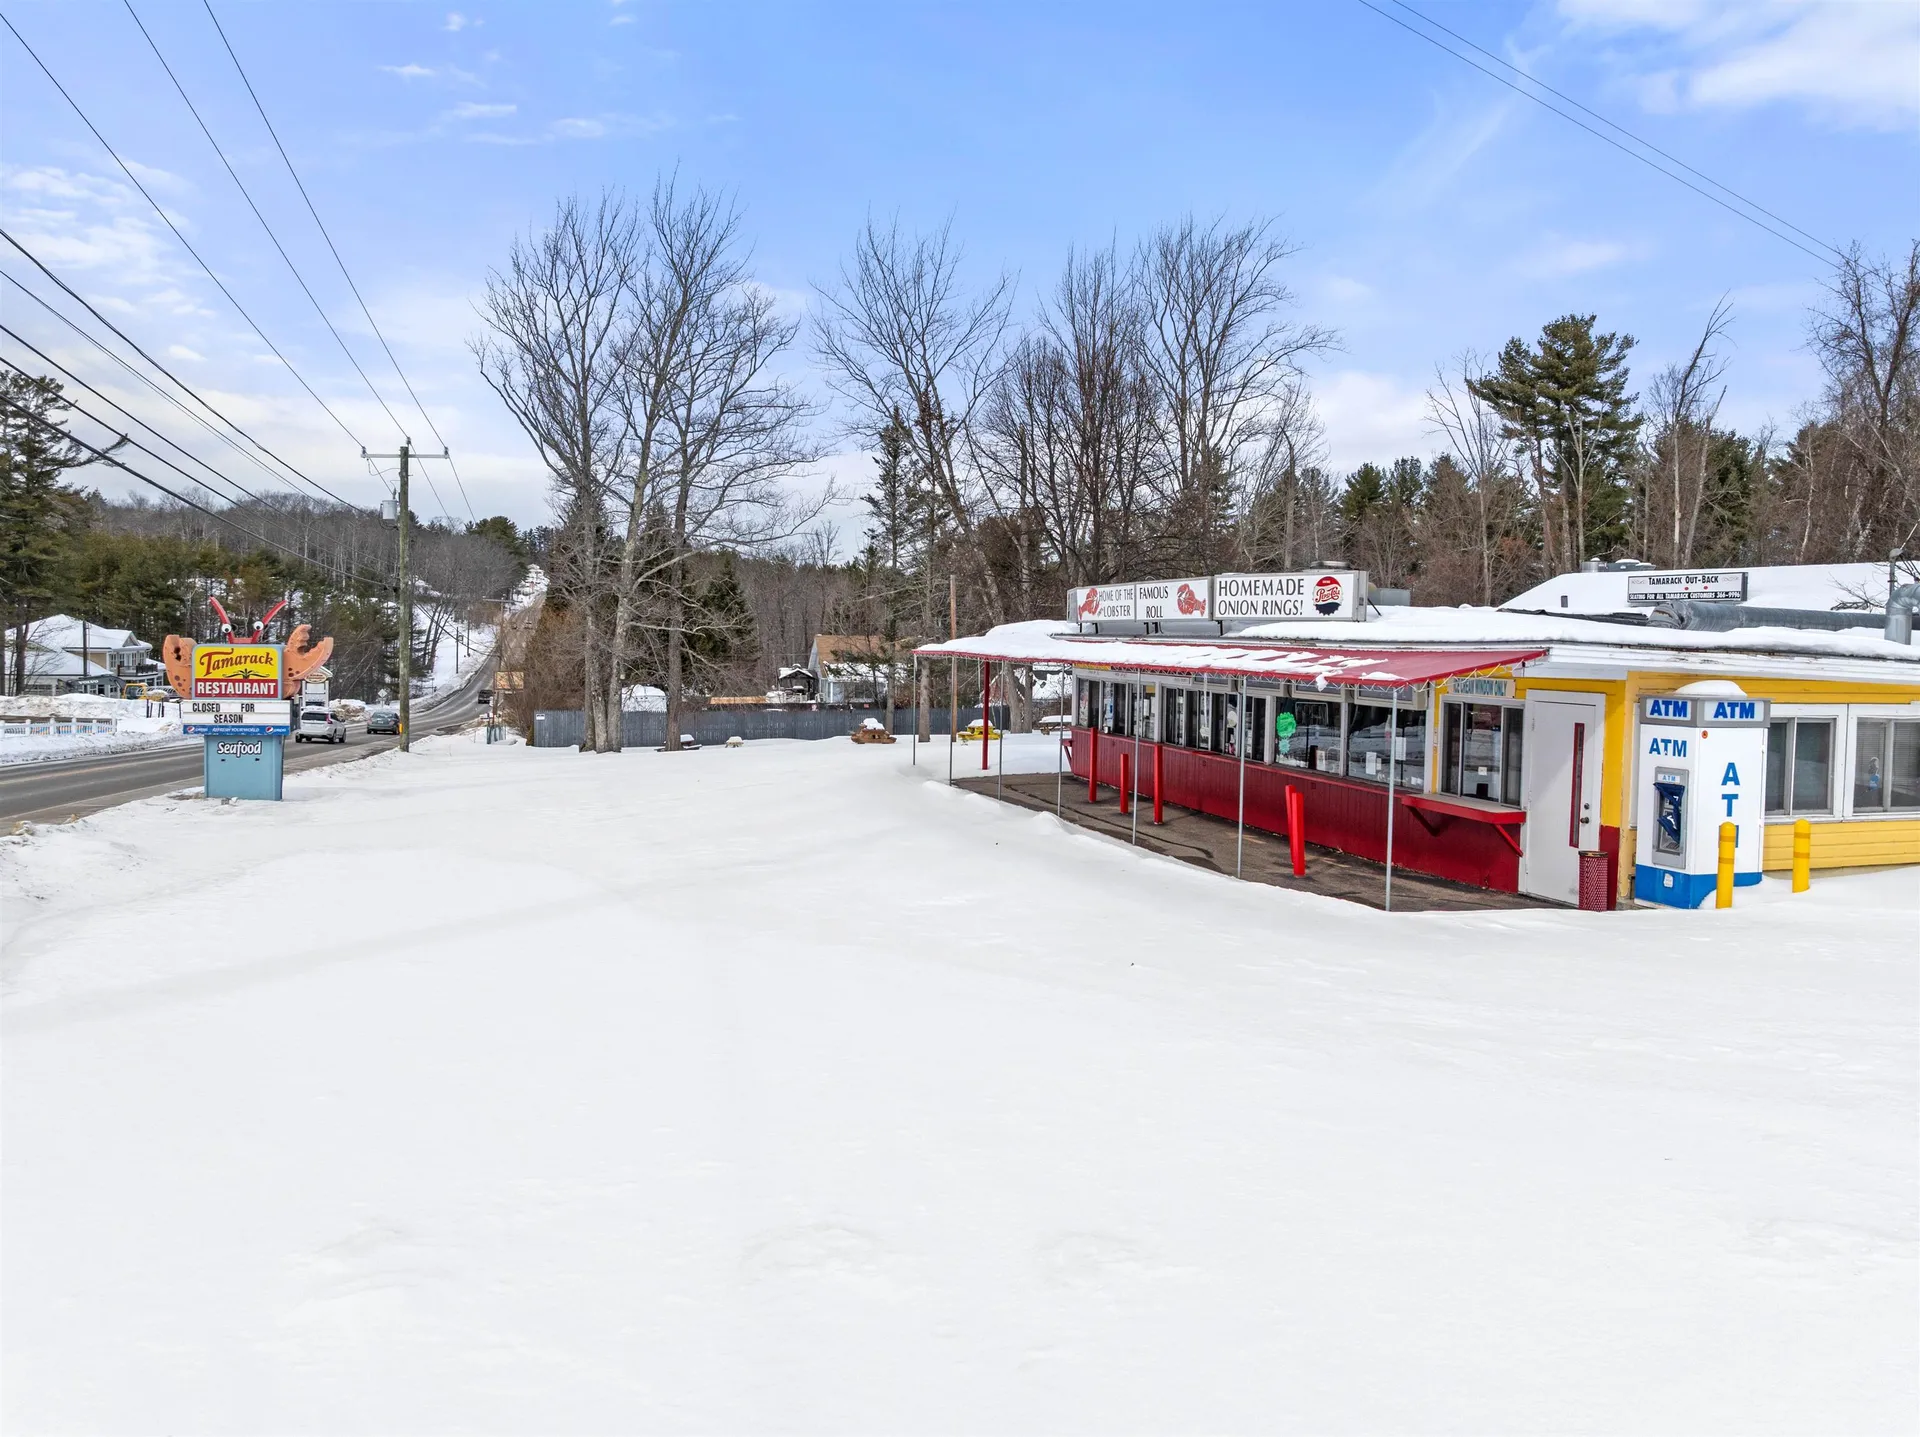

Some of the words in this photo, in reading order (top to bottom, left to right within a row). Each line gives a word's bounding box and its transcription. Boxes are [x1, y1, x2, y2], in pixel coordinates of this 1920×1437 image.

[1218, 579, 1304, 596] HOMEMADE
[1648, 577, 1682, 585] TAMARACK
[1685, 575, 1719, 584] OUT-BACK
[1099, 590, 1113, 602] HOME
[1115, 589, 1122, 602] OF
[1123, 588, 1134, 600] THE
[1139, 586, 1169, 600] FAMOUS
[1103, 605, 1131, 617] LOBSTER
[1146, 605, 1163, 618] ROLL
[1218, 600, 1258, 615] ONION
[1261, 599, 1303, 615] RINGS!
[200, 648, 274, 677] Tamarack
[197, 682, 276, 694] RESTAURANT
[192, 703, 220, 712] CLOSED
[241, 703, 255, 712] FOR
[1650, 699, 1688, 717] ATM
[1714, 702, 1755, 718] ATM
[214, 714, 243, 723] SEASON
[218, 741, 262, 757] Seafood
[1649, 738, 1687, 757] ATM
[1719, 762, 1740, 848] AT
